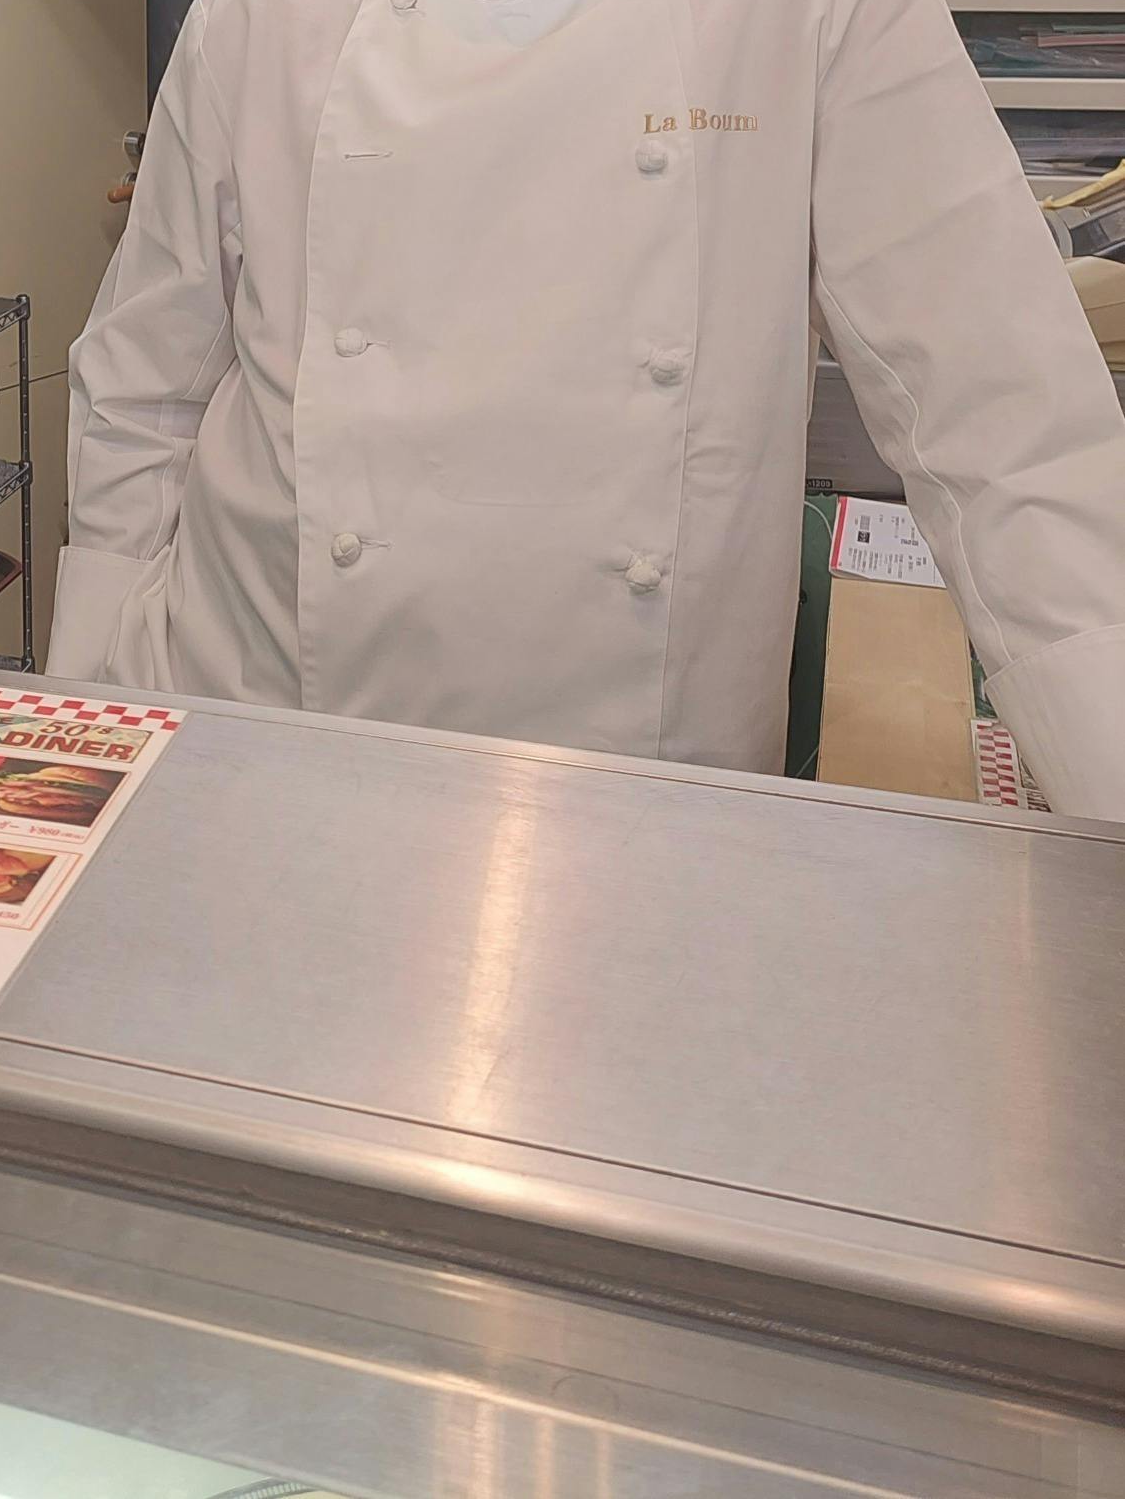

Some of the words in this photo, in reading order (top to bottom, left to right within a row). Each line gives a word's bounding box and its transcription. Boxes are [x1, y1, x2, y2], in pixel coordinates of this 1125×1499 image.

[644, 114, 677, 134] La
[689, 108, 758, 131] Boum
[40, 720, 116, 738] 50's
[0, 730, 136, 761] DINER
